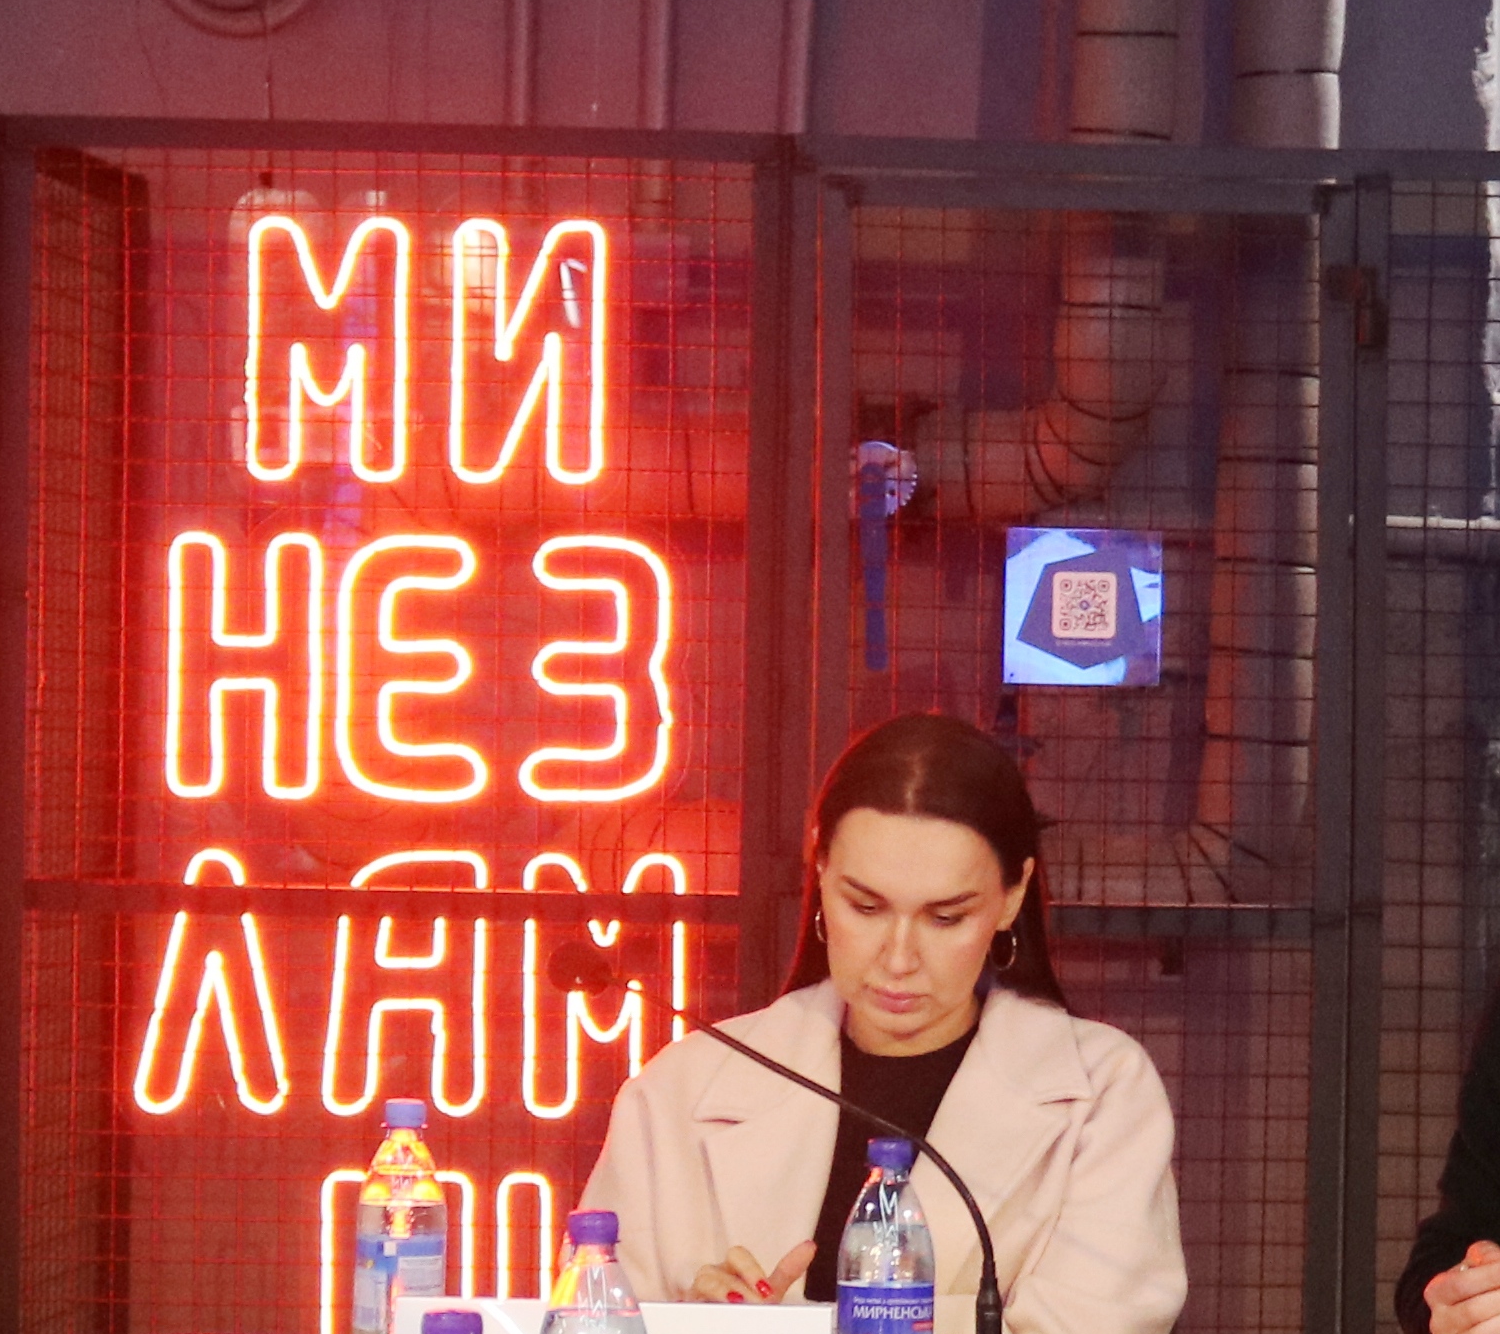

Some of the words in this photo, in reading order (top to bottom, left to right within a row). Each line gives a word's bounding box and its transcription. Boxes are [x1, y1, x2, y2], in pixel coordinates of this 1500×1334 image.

[245, 214, 608, 483] МИ
[167, 531, 674, 802] НЕЗ
[134, 848, 688, 1118] ЛАМ
